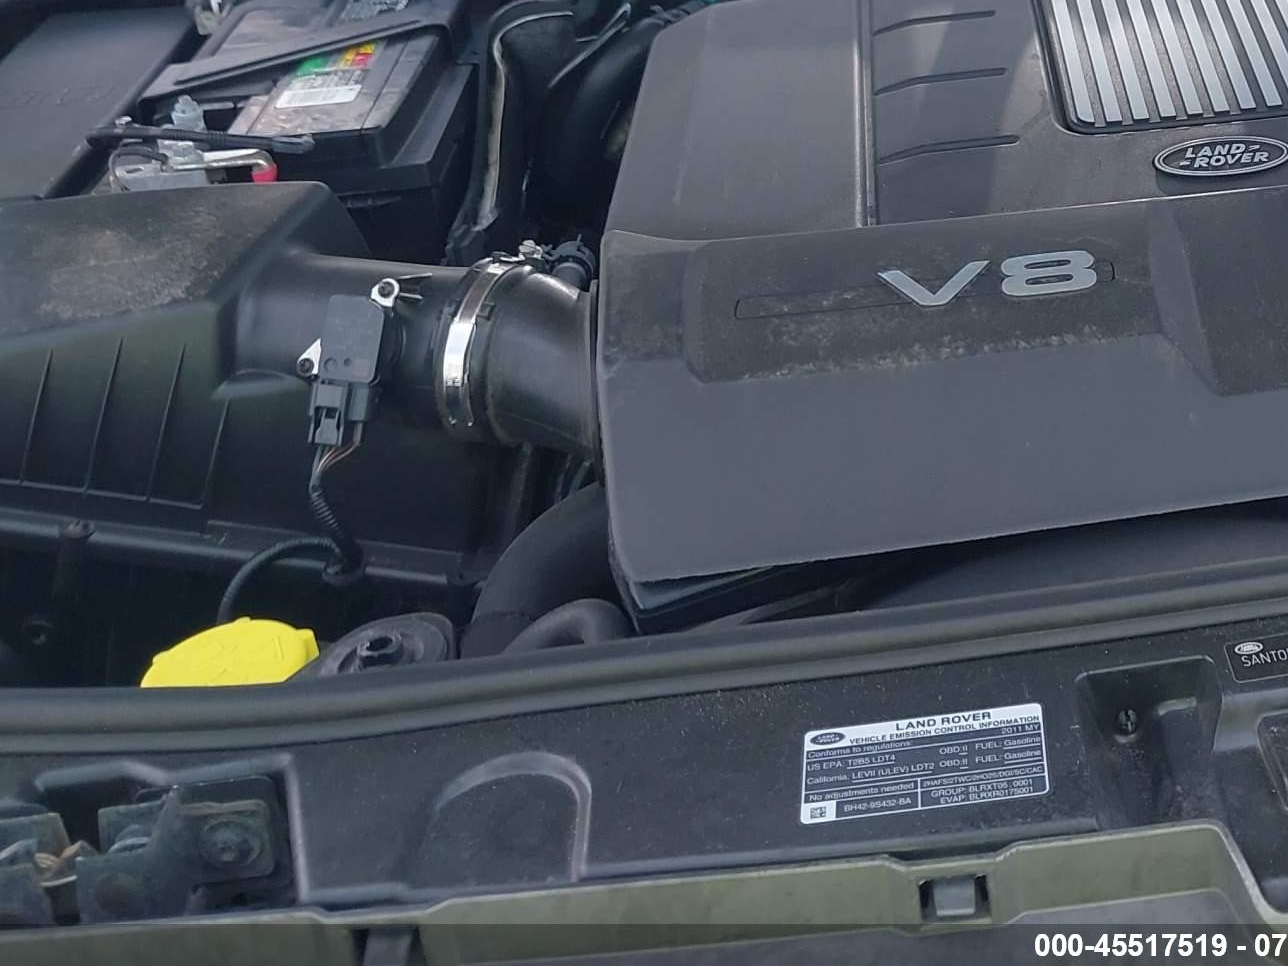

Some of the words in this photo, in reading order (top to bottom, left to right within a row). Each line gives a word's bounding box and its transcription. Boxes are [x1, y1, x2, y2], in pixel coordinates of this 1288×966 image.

[1185, 143, 1246, 158] LAND
[1193, 151, 1270, 168] ROVER
[877, 250, 1098, 307] V8
[895, 718, 936, 731] LAND
[941, 711, 993, 725] ROVER
[1001, 725, 1022, 735] 2011
[1025, 723, 1040, 731] MY
[849, 734, 887, 745] VEHICLE
[890, 728, 932, 740] EMISSION
[934, 723, 976, 735] CONTROL
[979, 715, 1040, 728] INFORMATION
[975, 740, 1002, 750] FUEL:
[1003, 736, 1041, 747] Gasoline
[808, 748, 851, 759] Conforms
[852, 746, 861, 754] to
[975, 754, 1001, 764] FUEL:
[1003, 750, 1041, 760] Gasoline
[807, 763, 821, 771] US
[823, 761, 845, 770] EPA:
[848, 756, 871, 766] T2B5
[872, 754, 896, 764] LDT4
[852, 769, 876, 779] LEVII
[878, 765, 909, 777] (ULEV)
[911, 762, 935, 772] LDT2
[809, 794, 822, 802] No
[824, 785, 879, 800] adjustments
[881, 781, 914, 792] needed
[931, 786, 967, 797] GROUP:
[941, 794, 967, 804] EVAP:
